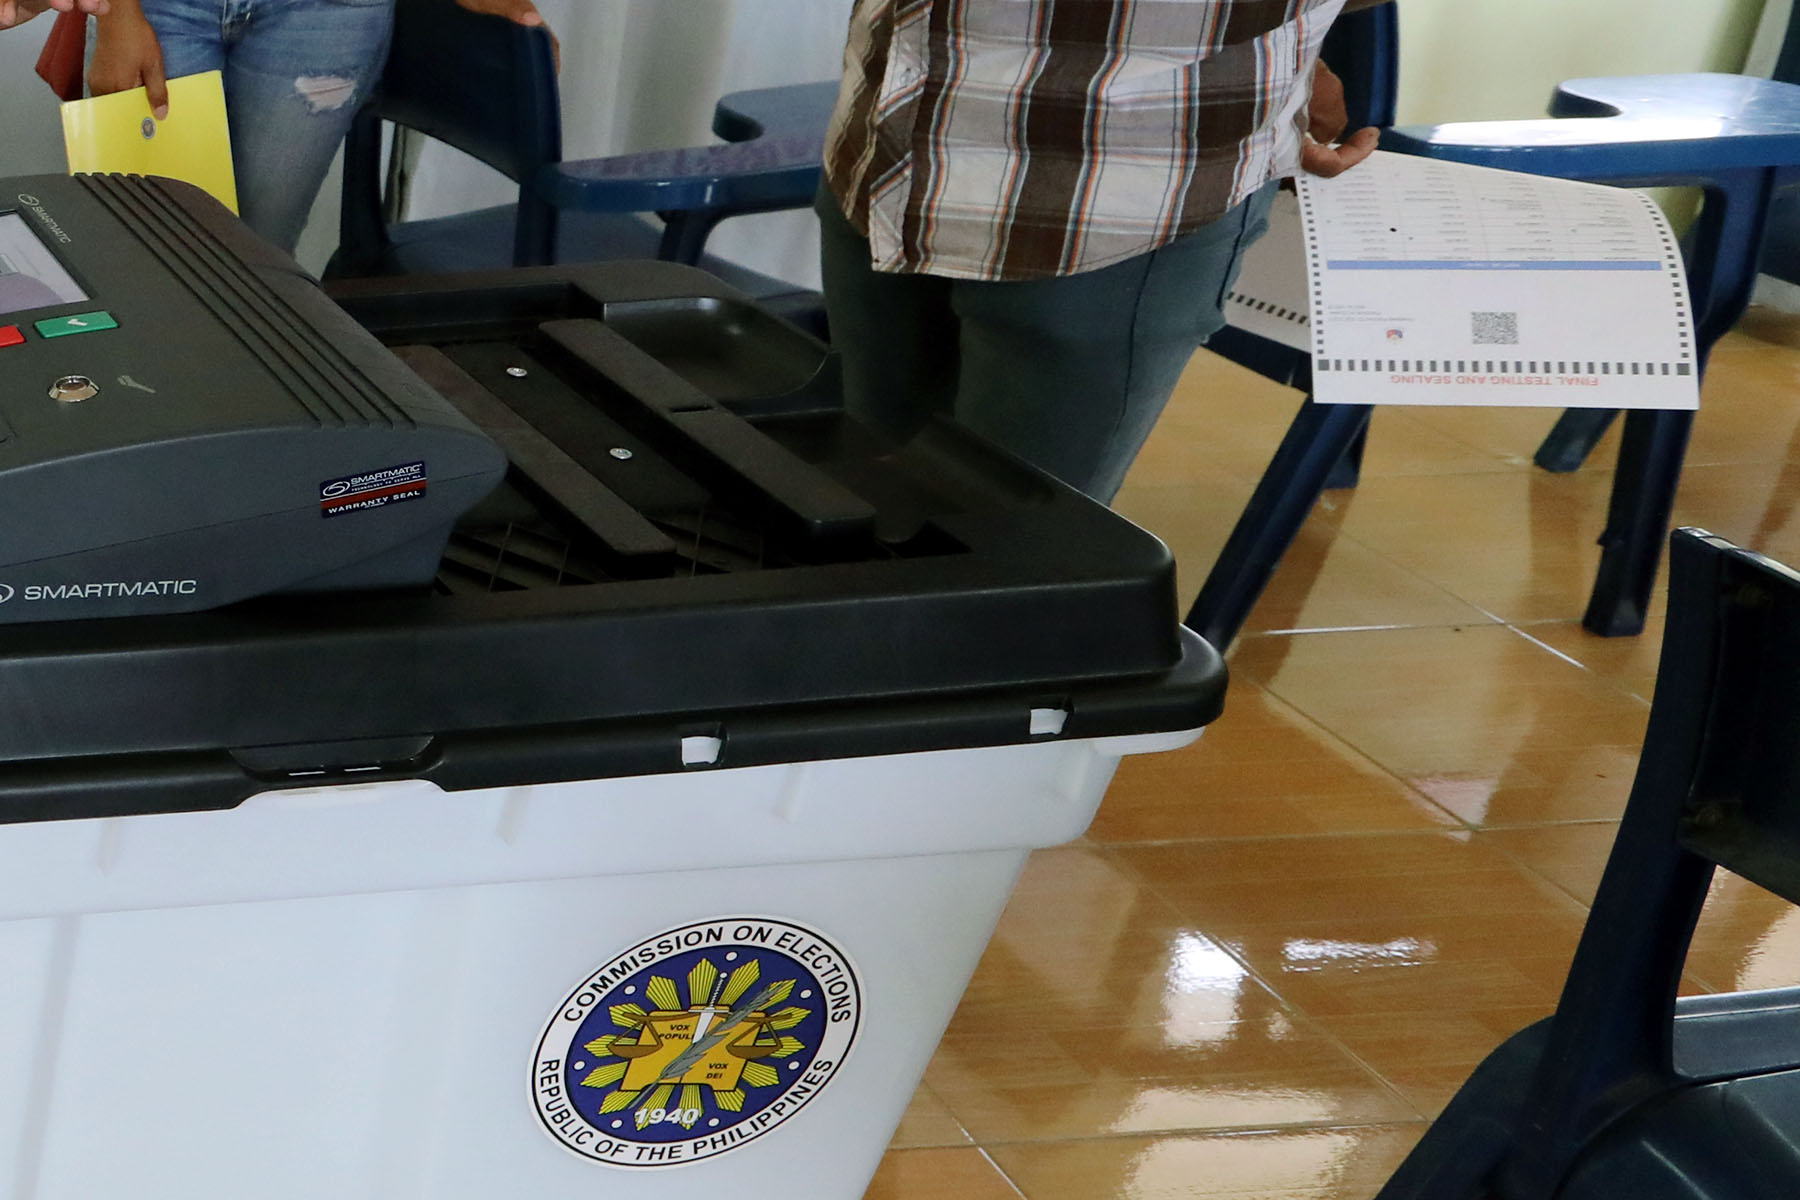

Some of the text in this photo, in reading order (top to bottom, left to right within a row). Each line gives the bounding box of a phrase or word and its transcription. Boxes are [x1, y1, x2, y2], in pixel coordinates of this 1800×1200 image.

[1390, 374, 1600, 387] FINAL TESTING AND SEALING
[350, 463, 423, 486] SMARTMATIC
[328, 496, 389, 514] WARRANTY
[393, 489, 421, 501] SEAL
[23, 579, 198, 601] SMARTMATIC
[564, 925, 852, 1024] COMMISSION ON ELECTIONS
[541, 1058, 834, 1162] REPUBLIC OF THE PHILIPPINES
[634, 1107, 700, 1126] 1940
